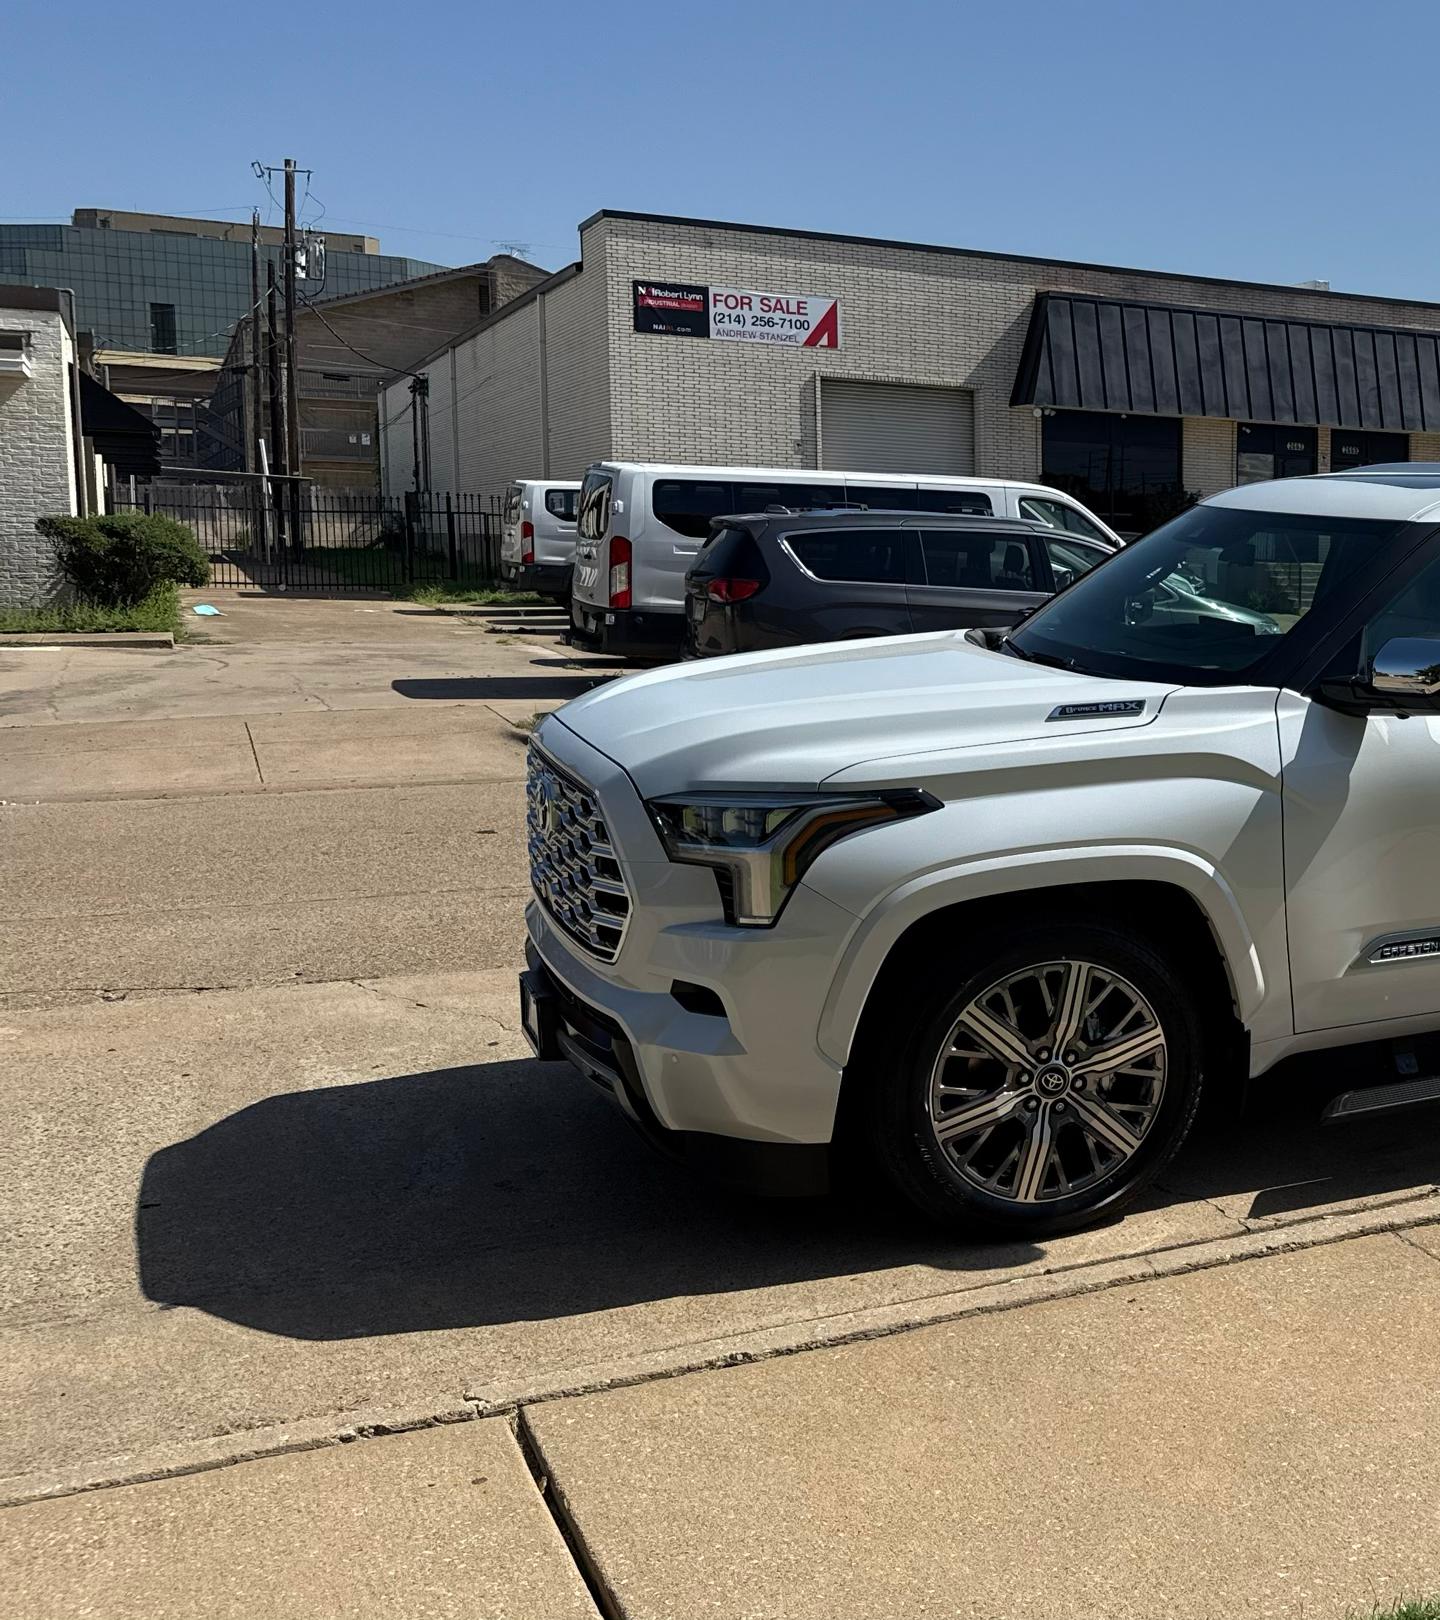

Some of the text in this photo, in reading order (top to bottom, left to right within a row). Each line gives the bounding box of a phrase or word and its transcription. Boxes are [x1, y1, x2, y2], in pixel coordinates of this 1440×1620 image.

[655, 289, 683, 299] Robert
[684, 291, 704, 301] Lynn
[713, 293, 808, 316] FOR SALE
[713, 312, 810, 331] (214) 256-7100
[715, 328, 800, 343] ANDREW STANZEL
[1099, 701, 1139, 712] MAX
